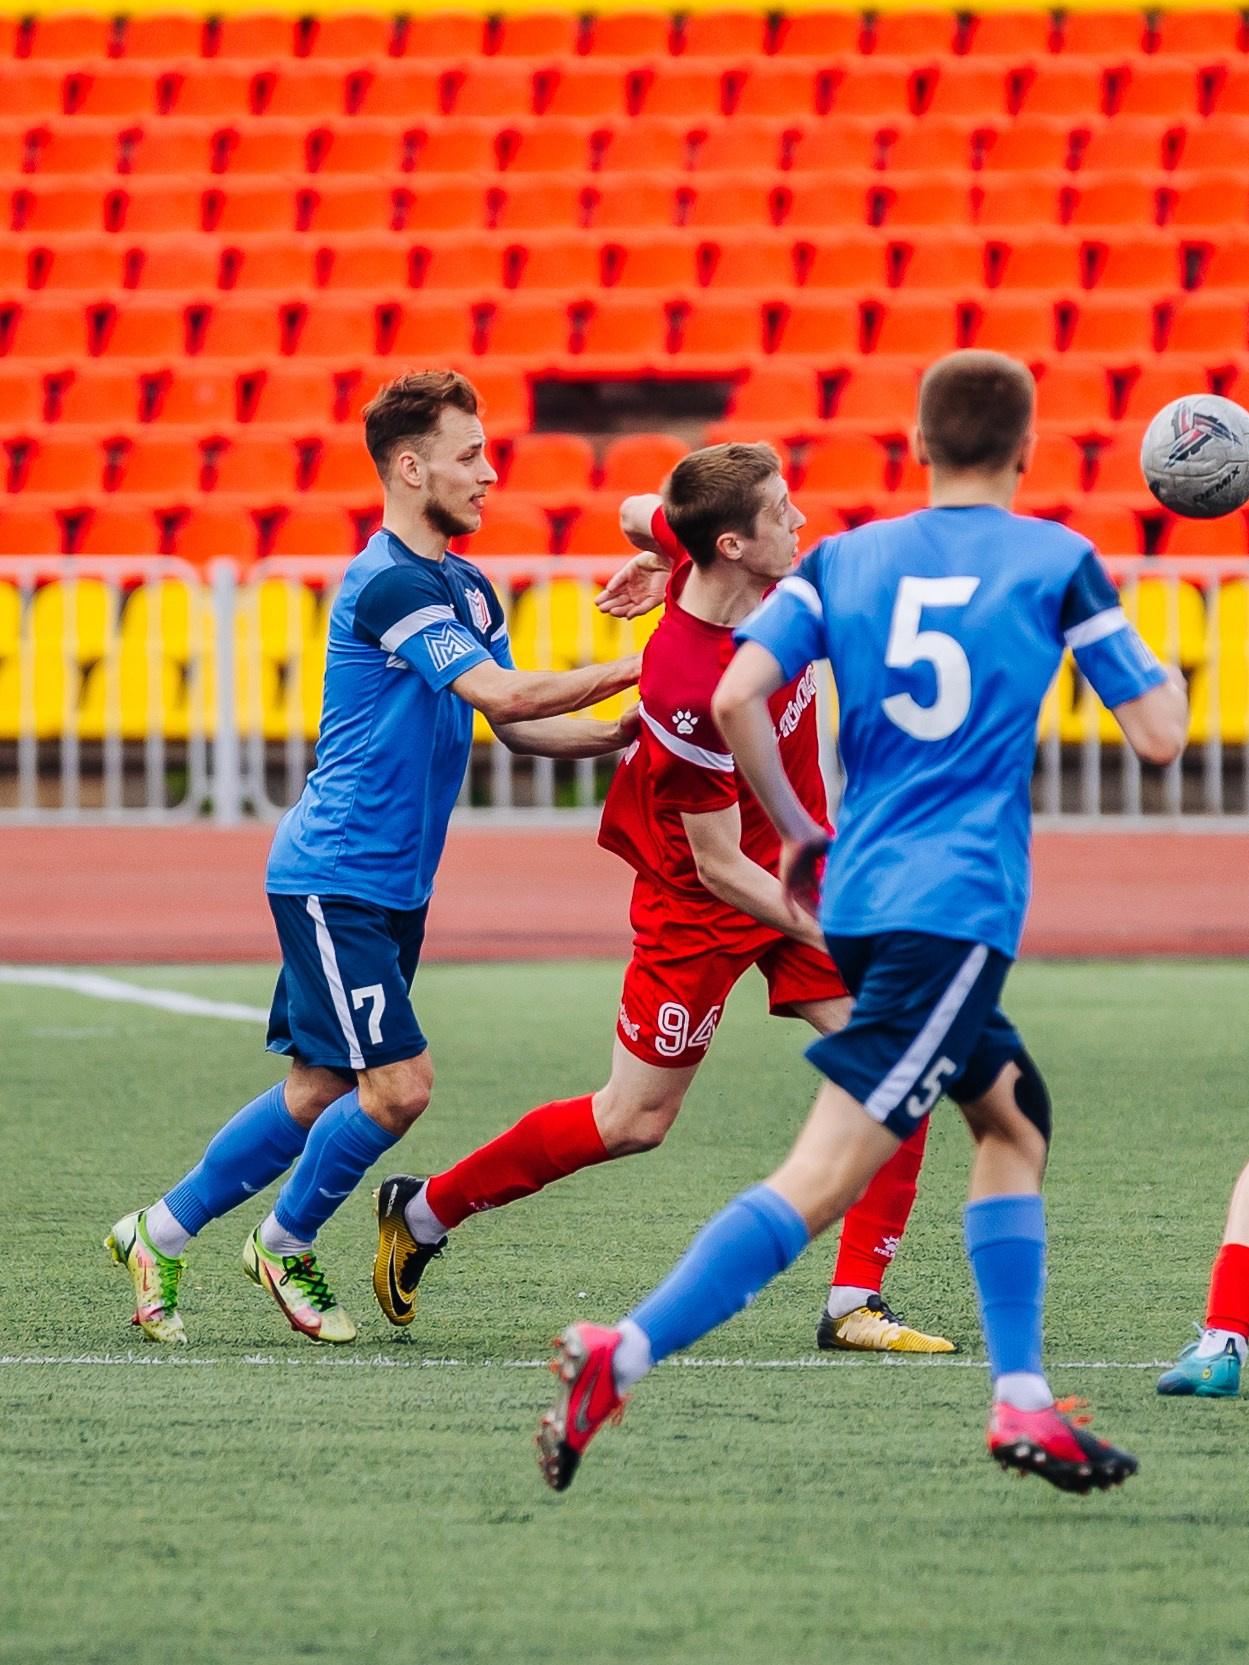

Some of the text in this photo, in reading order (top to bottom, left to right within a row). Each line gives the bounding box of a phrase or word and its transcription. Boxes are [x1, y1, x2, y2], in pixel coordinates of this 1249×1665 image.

[881, 576, 981, 741] 5
[350, 983, 387, 1045] 7
[654, 1001, 721, 1057] 94
[907, 1056, 957, 1118] 5
